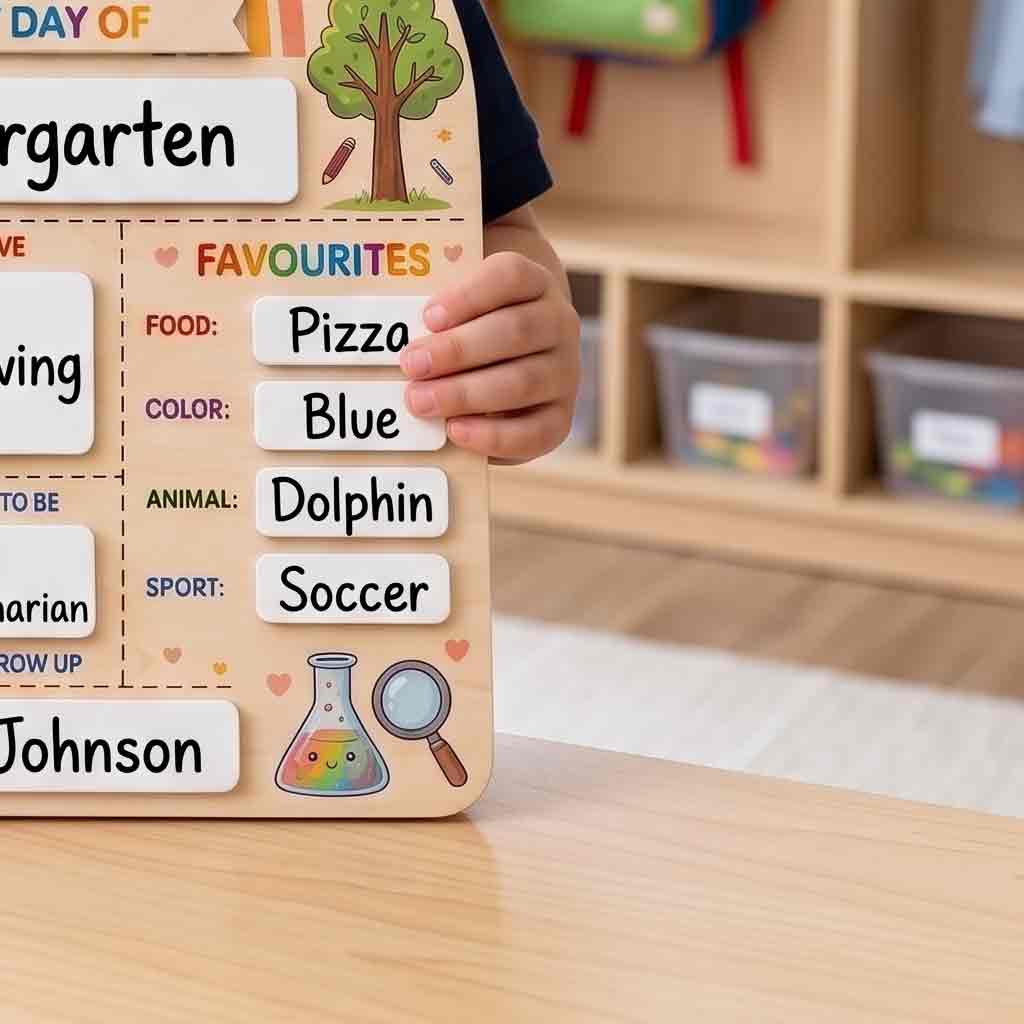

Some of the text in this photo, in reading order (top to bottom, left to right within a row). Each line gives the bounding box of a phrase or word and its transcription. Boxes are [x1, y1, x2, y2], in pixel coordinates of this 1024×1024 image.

[12, 5, 88, 39] DAY
[99, 5, 152, 39] OF
[197, 243, 431, 277] FAVOURITES
[146, 315, 218, 336] FOOD:
[289, 307, 409, 353] Pizza
[146, 399, 230, 419] COLOR:
[303, 392, 399, 439] Blue
[0, 493, 28, 512] TO
[34, 493, 59, 512] BE
[147, 490, 238, 509] ANIMAL:
[272, 476, 432, 536] Dolphin
[146, 578, 224, 597] SPORT:
[279, 565, 429, 612] Soccer
[54, 654, 82, 673] UP
